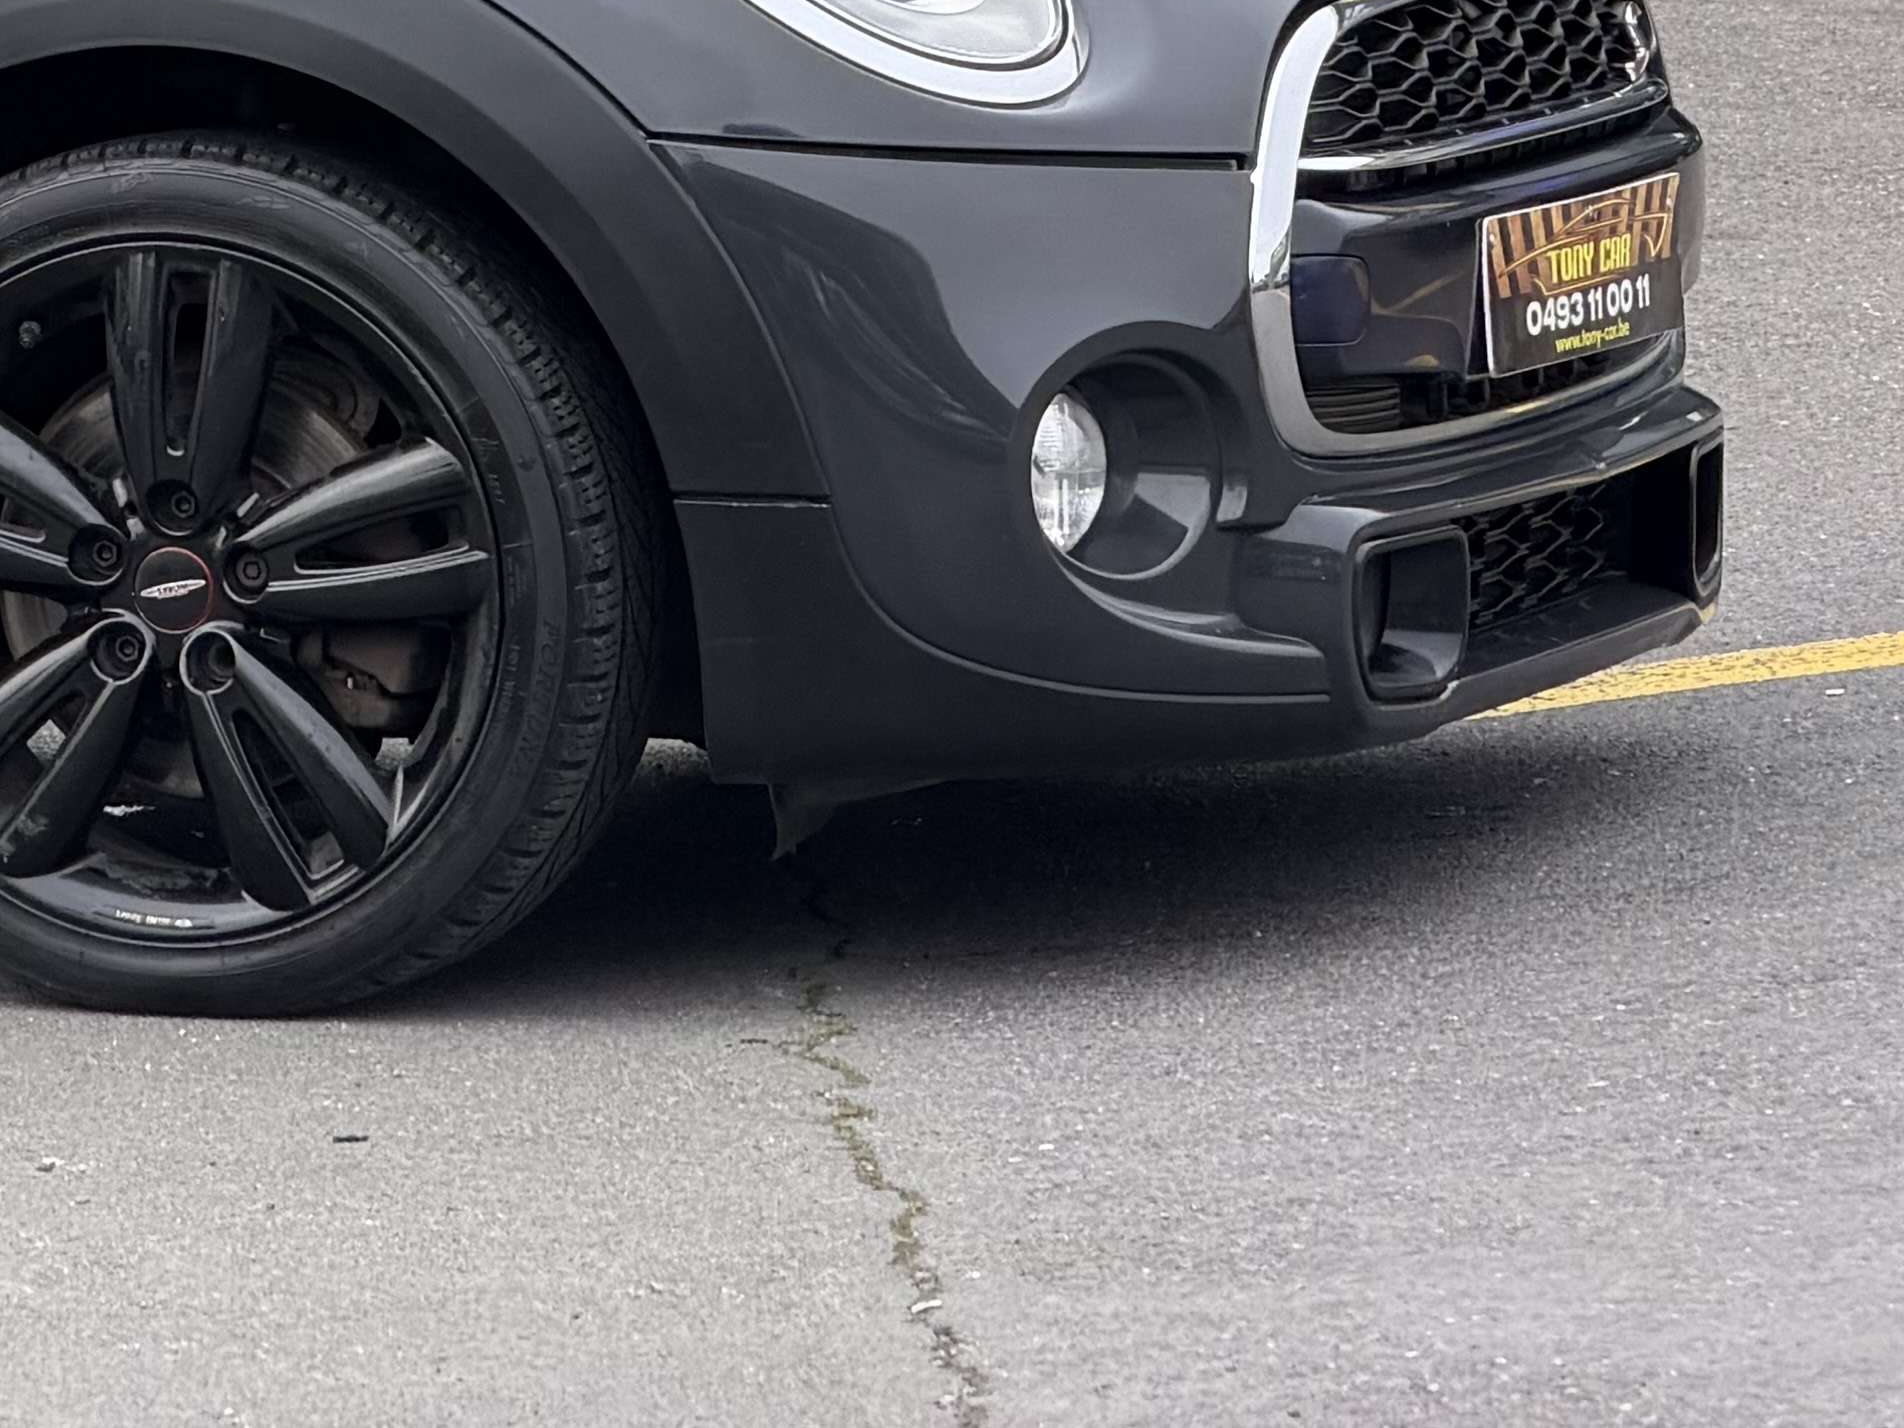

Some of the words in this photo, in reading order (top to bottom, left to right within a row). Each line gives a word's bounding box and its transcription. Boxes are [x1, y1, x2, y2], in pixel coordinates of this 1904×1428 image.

[1547, 241, 1594, 284] TONY
[1599, 233, 1632, 273] CAR
[1526, 292, 1584, 336] 0493
[1587, 287, 1603, 321] 11
[1606, 281, 1633, 316] 00
[1636, 272, 1650, 310] 11
[1555, 319, 1630, 354] www.tony-car.be
